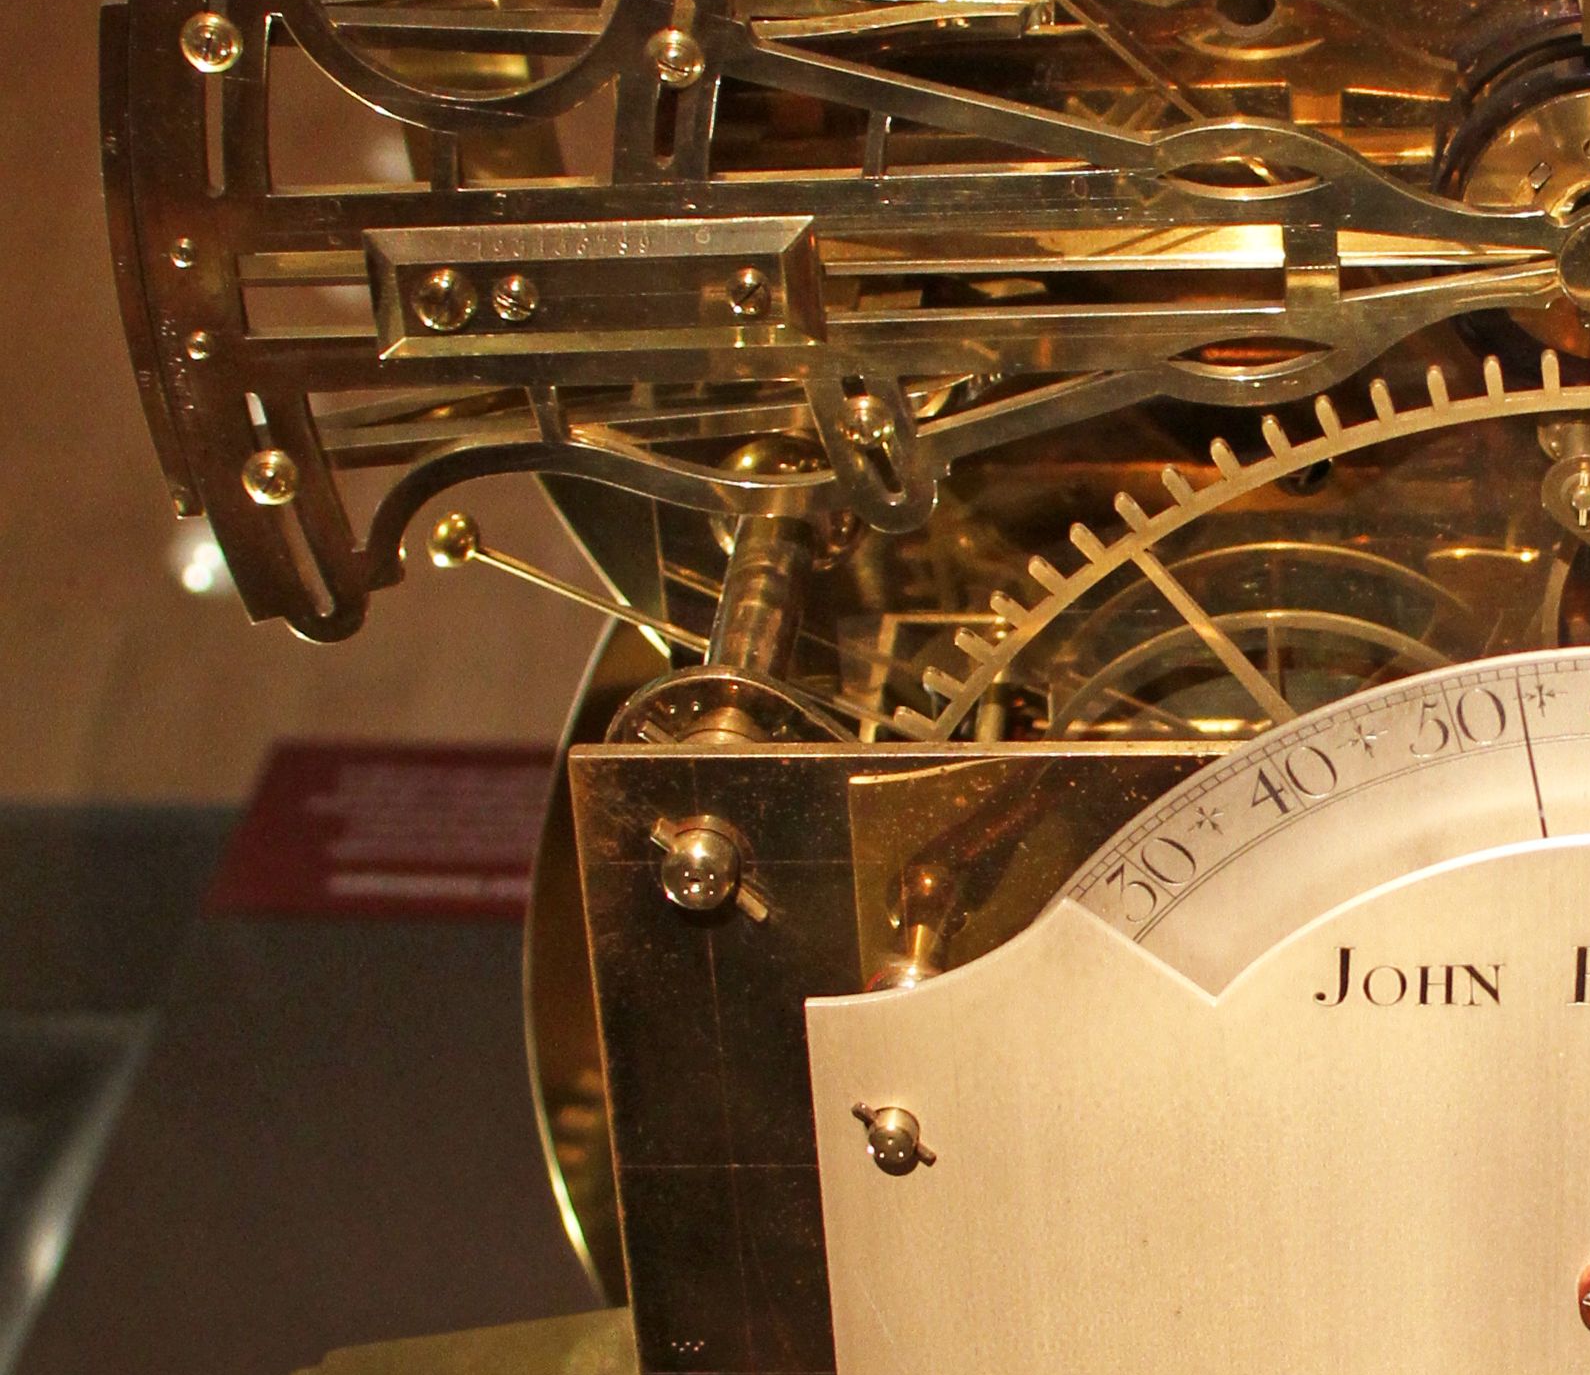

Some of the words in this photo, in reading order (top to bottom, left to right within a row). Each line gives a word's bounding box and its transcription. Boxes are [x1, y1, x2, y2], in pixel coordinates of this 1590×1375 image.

[1106, 836, 1197, 923] 30
[1250, 745, 1338, 817] 40
[1409, 686, 1507, 759] 50
[1313, 945, 1507, 1008] JOHN
